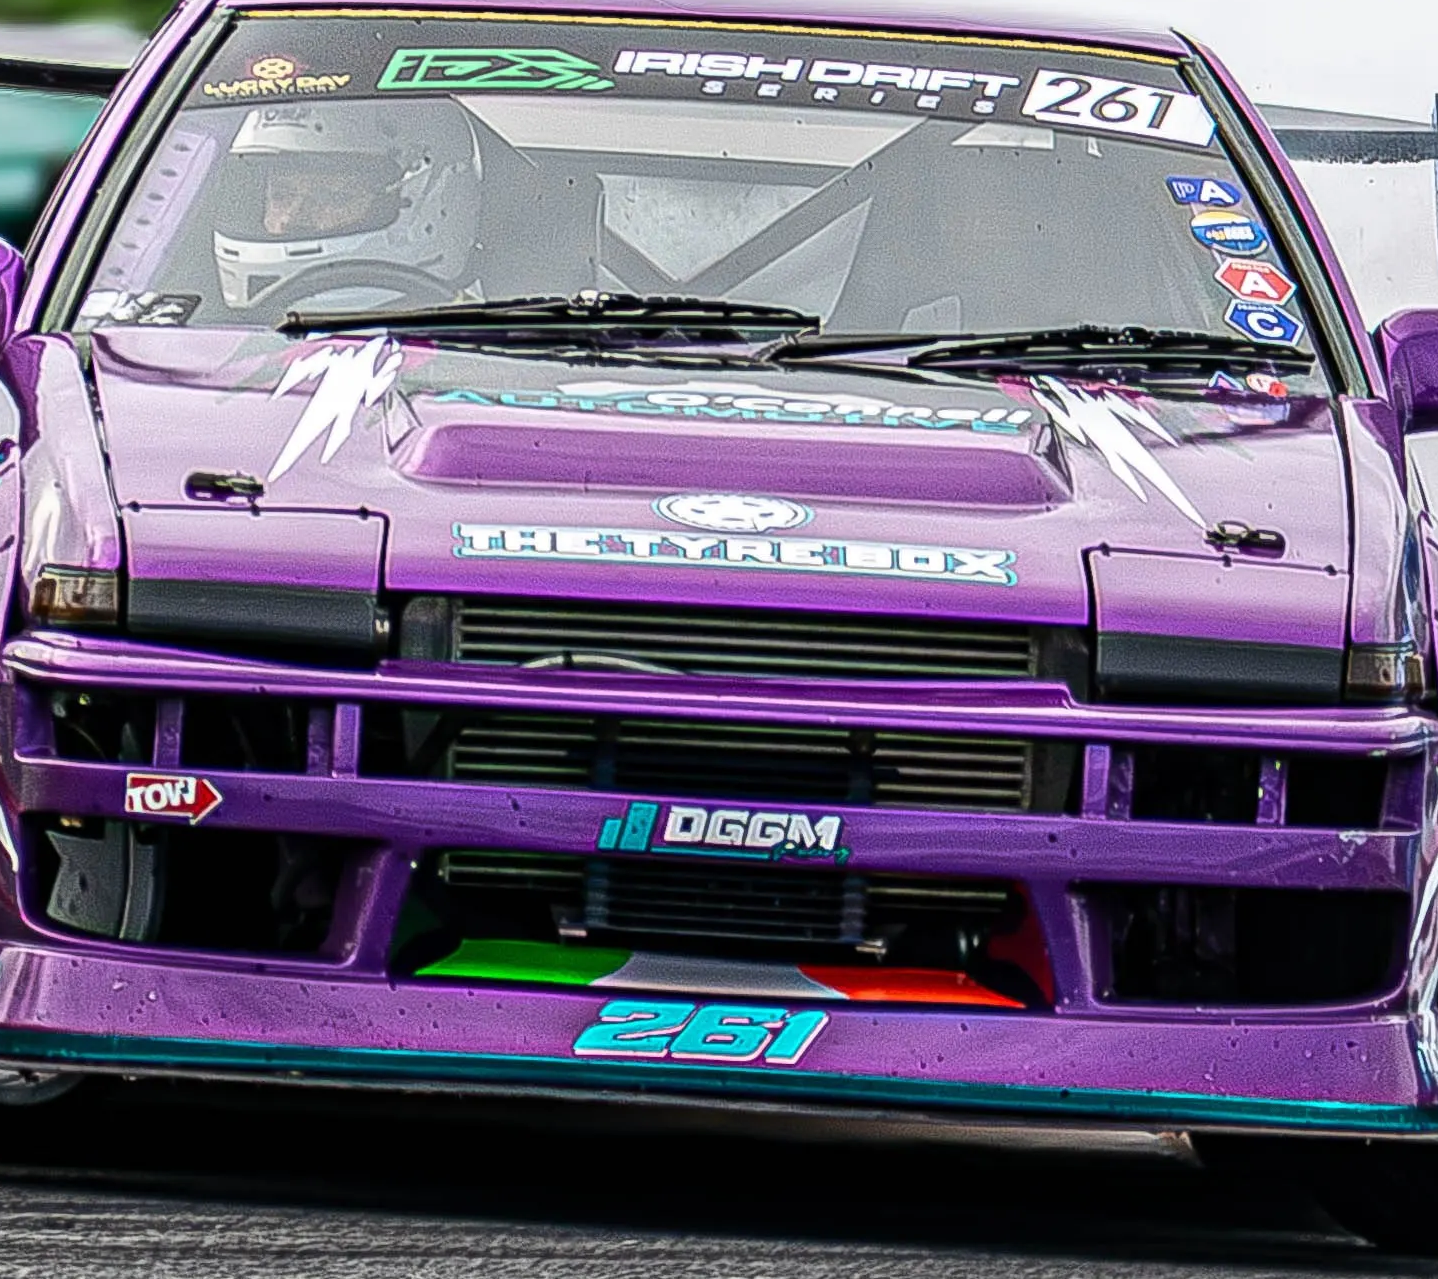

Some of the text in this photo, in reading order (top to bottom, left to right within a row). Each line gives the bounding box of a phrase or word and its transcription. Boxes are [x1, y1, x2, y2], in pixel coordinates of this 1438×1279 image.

[613, 50, 1021, 98] IRISH DRIFT
[700, 80, 997, 115] SERIES
[1043, 76, 1177, 130] 261
[466, 524, 1012, 580] THE TYRE BOX
[126, 777, 197, 813] TOW
[664, 804, 841, 851] DGGM
[572, 999, 833, 1067] 261
